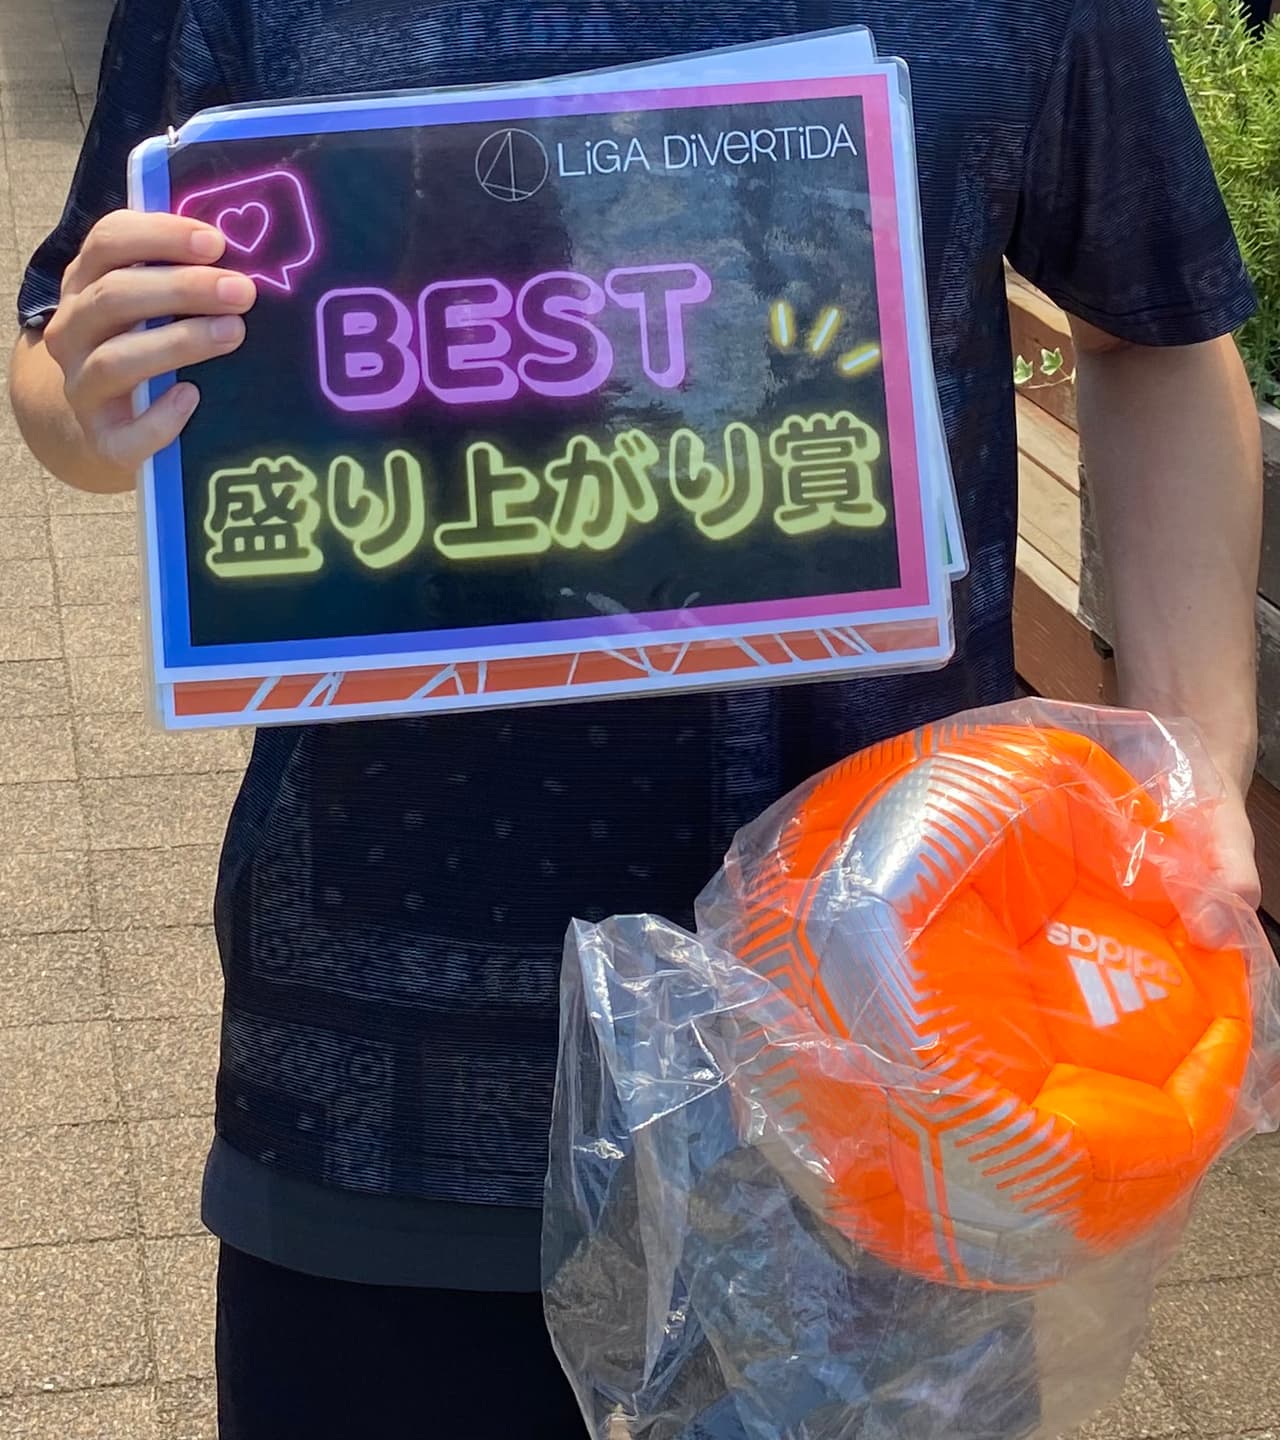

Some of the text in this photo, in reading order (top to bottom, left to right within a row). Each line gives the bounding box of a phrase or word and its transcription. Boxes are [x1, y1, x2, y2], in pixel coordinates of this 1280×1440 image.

[316, 262, 711, 412] BEST
[203, 409, 886, 579] 盛り上がり賞
[1046, 920, 1182, 987] adidas
